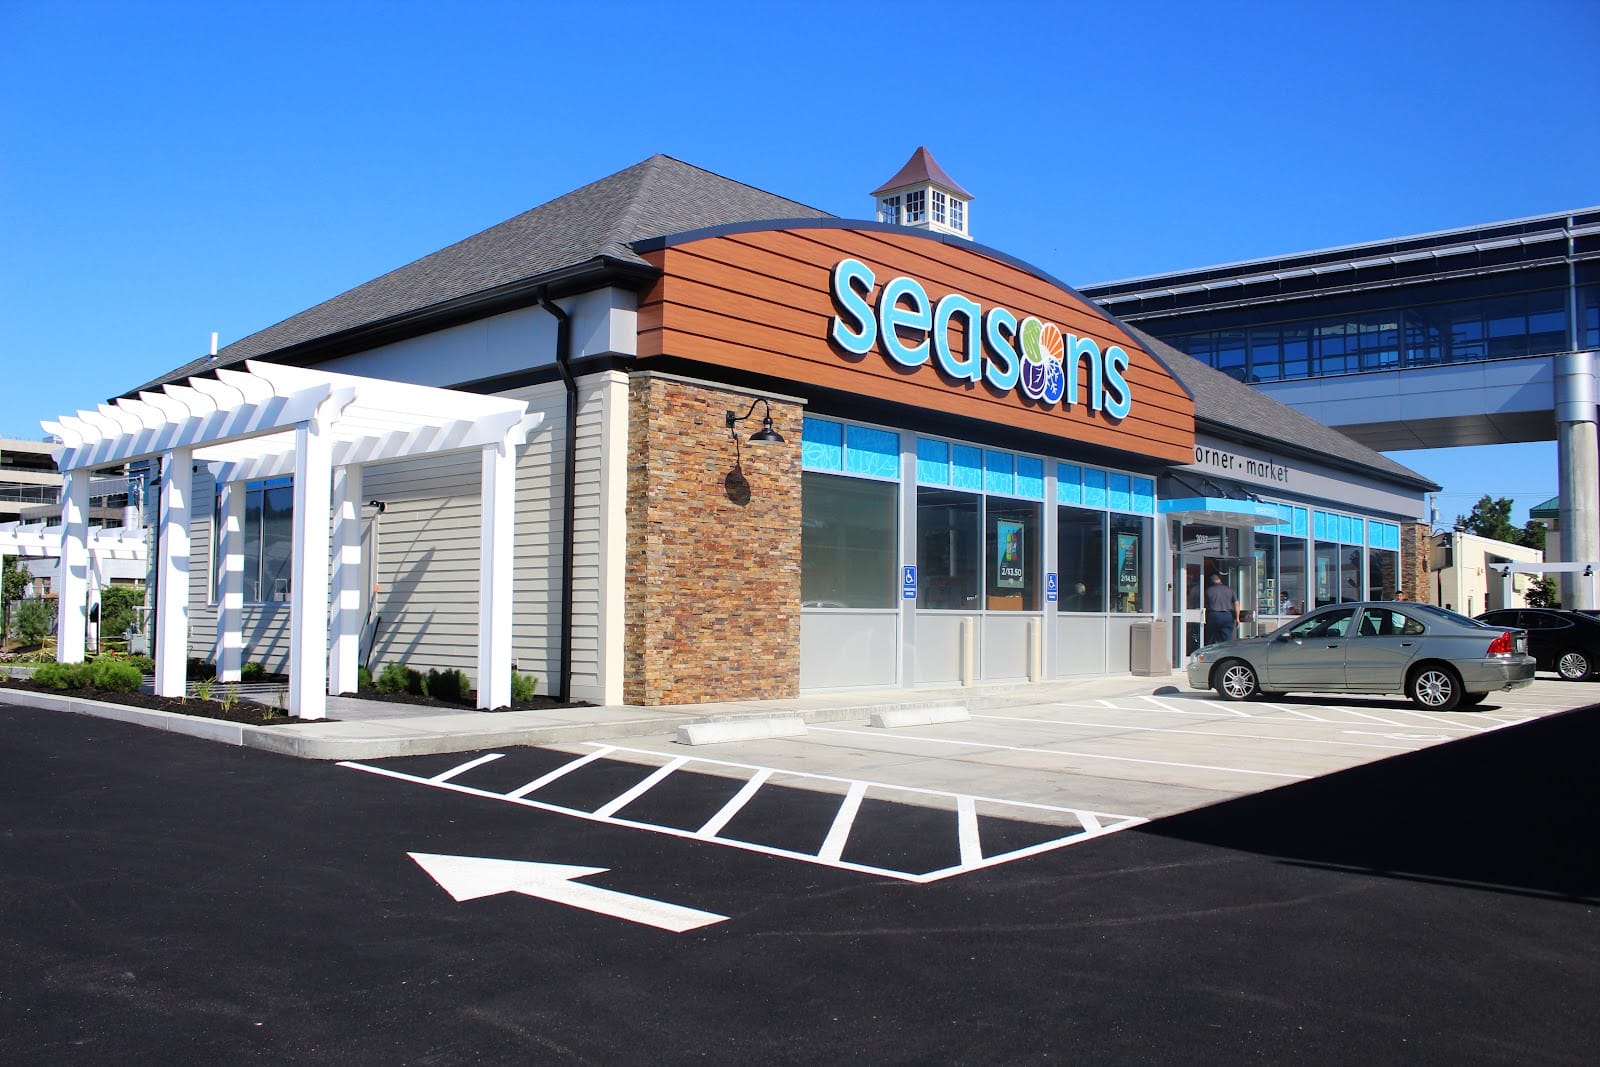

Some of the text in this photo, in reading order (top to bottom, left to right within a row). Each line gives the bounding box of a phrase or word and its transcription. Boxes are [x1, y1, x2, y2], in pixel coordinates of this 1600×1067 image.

[830, 258, 1131, 420] seasons
[1195, 447, 1289, 483] orner market
